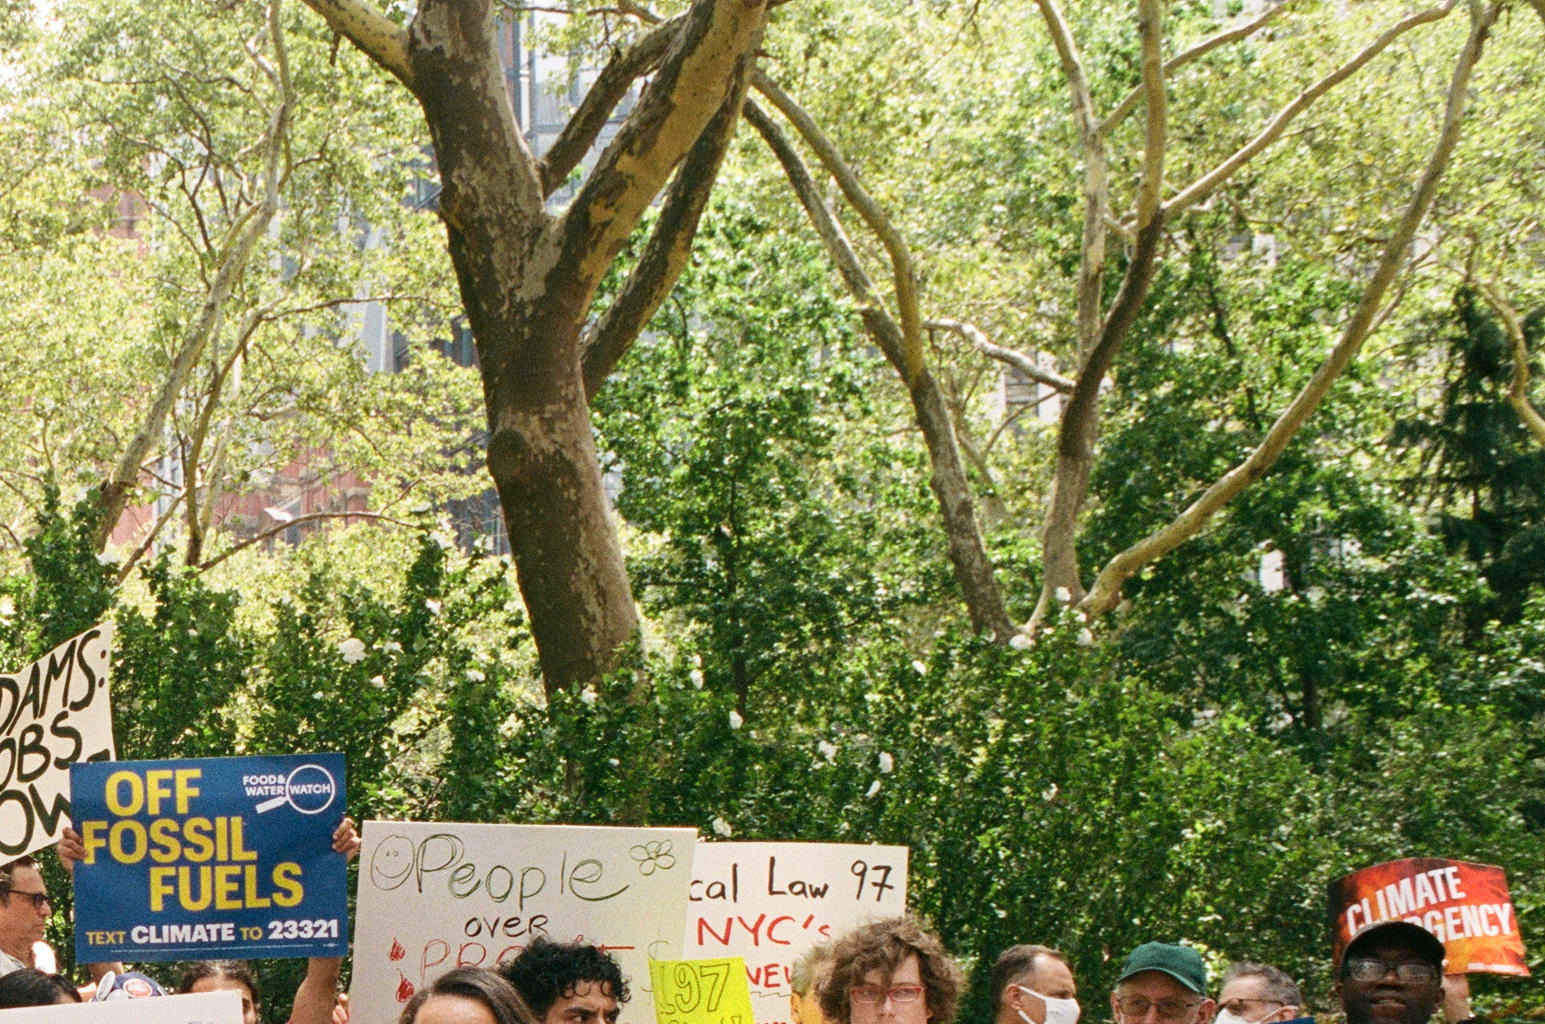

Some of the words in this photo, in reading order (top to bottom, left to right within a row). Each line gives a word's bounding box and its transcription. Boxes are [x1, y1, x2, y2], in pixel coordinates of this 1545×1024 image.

[105, 768, 201, 816] OFF
[245, 786, 285, 797] WATER
[289, 784, 331, 794] WATCH
[82, 816, 257, 865] FOSSIL
[150, 860, 303, 912] FUELS
[416, 834, 630, 910] People
[768, 856, 829, 898] Law
[851, 860, 894, 902] 97
[1346, 866, 1466, 937] CLIMATE
[1406, 903, 1512, 943] GENCY
[86, 931, 126, 945] TEXT
[131, 923, 235, 944] CLIMATE
[240, 926, 262, 940] TO
[268, 919, 338, 939] 23321
